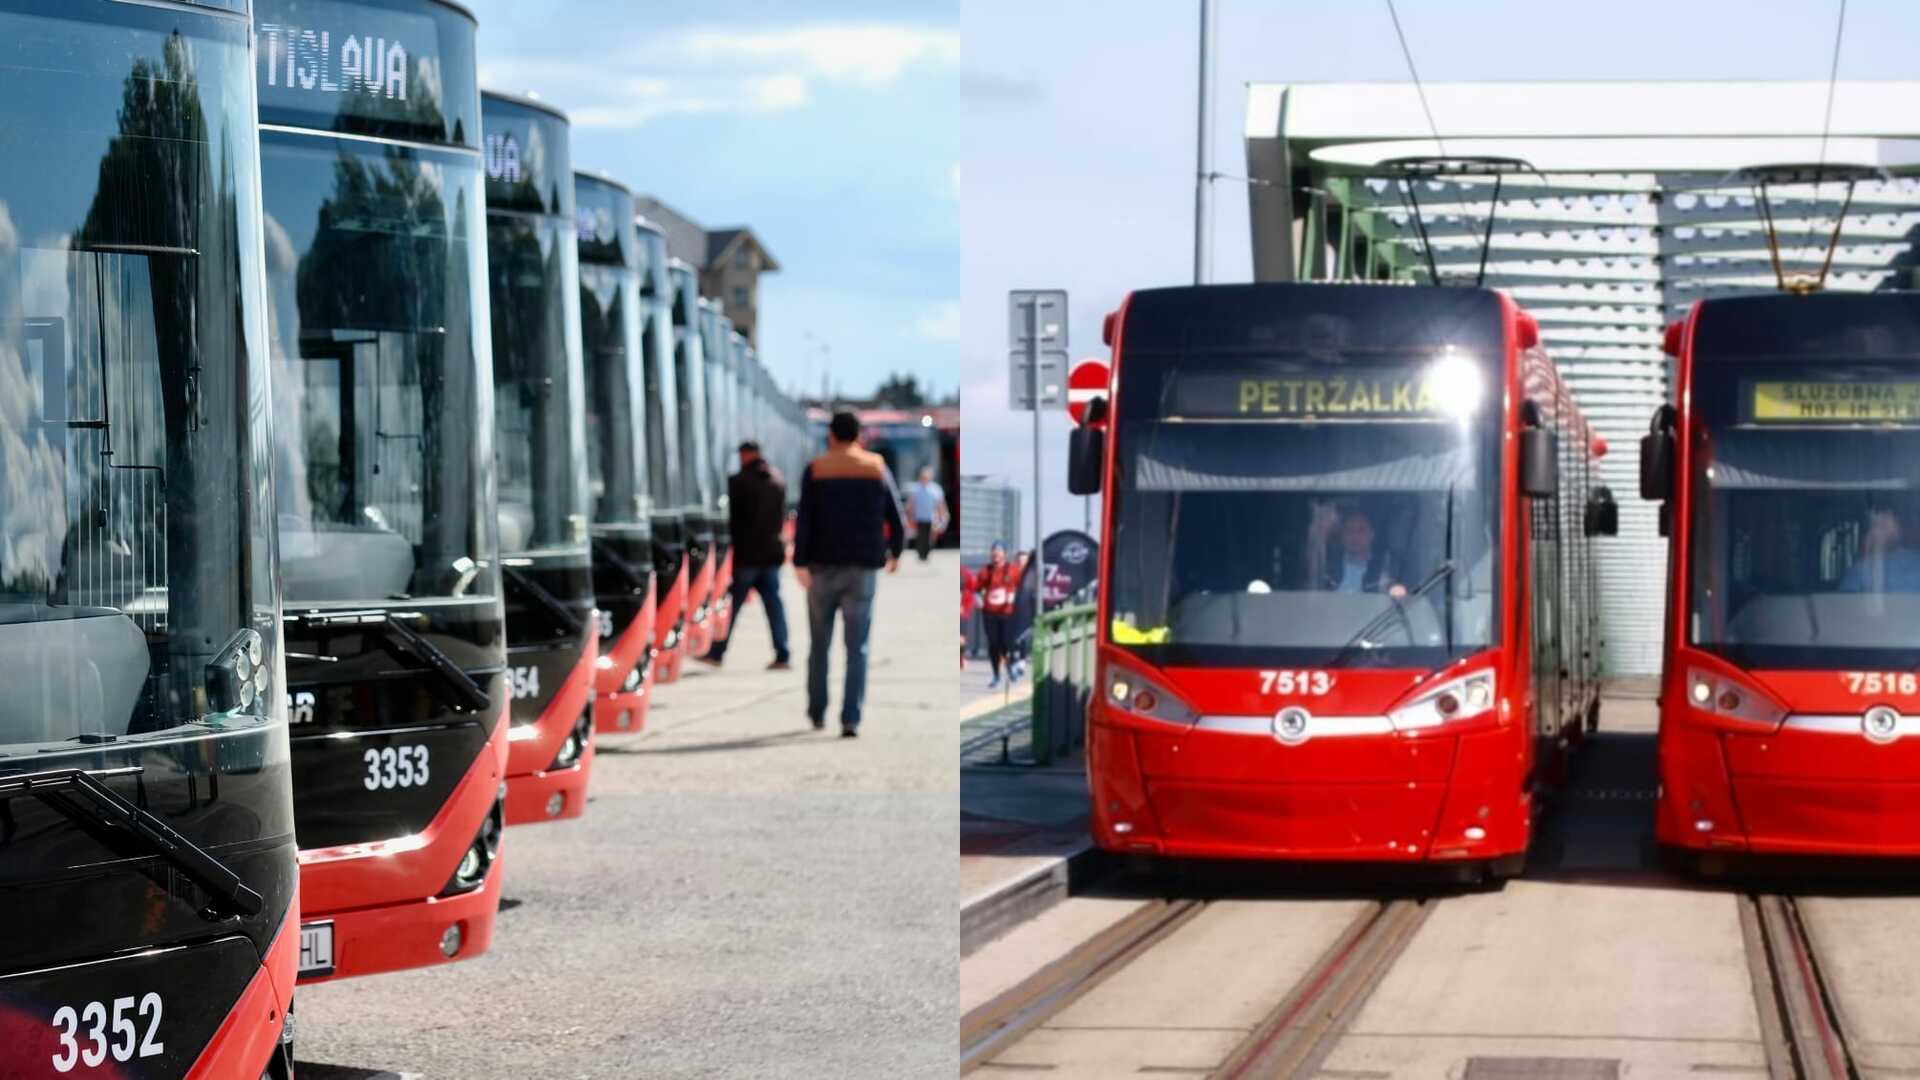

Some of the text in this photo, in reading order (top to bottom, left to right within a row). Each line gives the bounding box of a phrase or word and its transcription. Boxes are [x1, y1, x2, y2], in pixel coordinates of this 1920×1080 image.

[254, 23, 406, 100] TISLAVA
[1239, 377, 1435, 412] PETRŽALKA
[1259, 670, 1329, 696] 7513
[1847, 671, 1917, 695] 7516
[364, 744, 429, 791] 3353
[52, 991, 164, 1073] 3352
